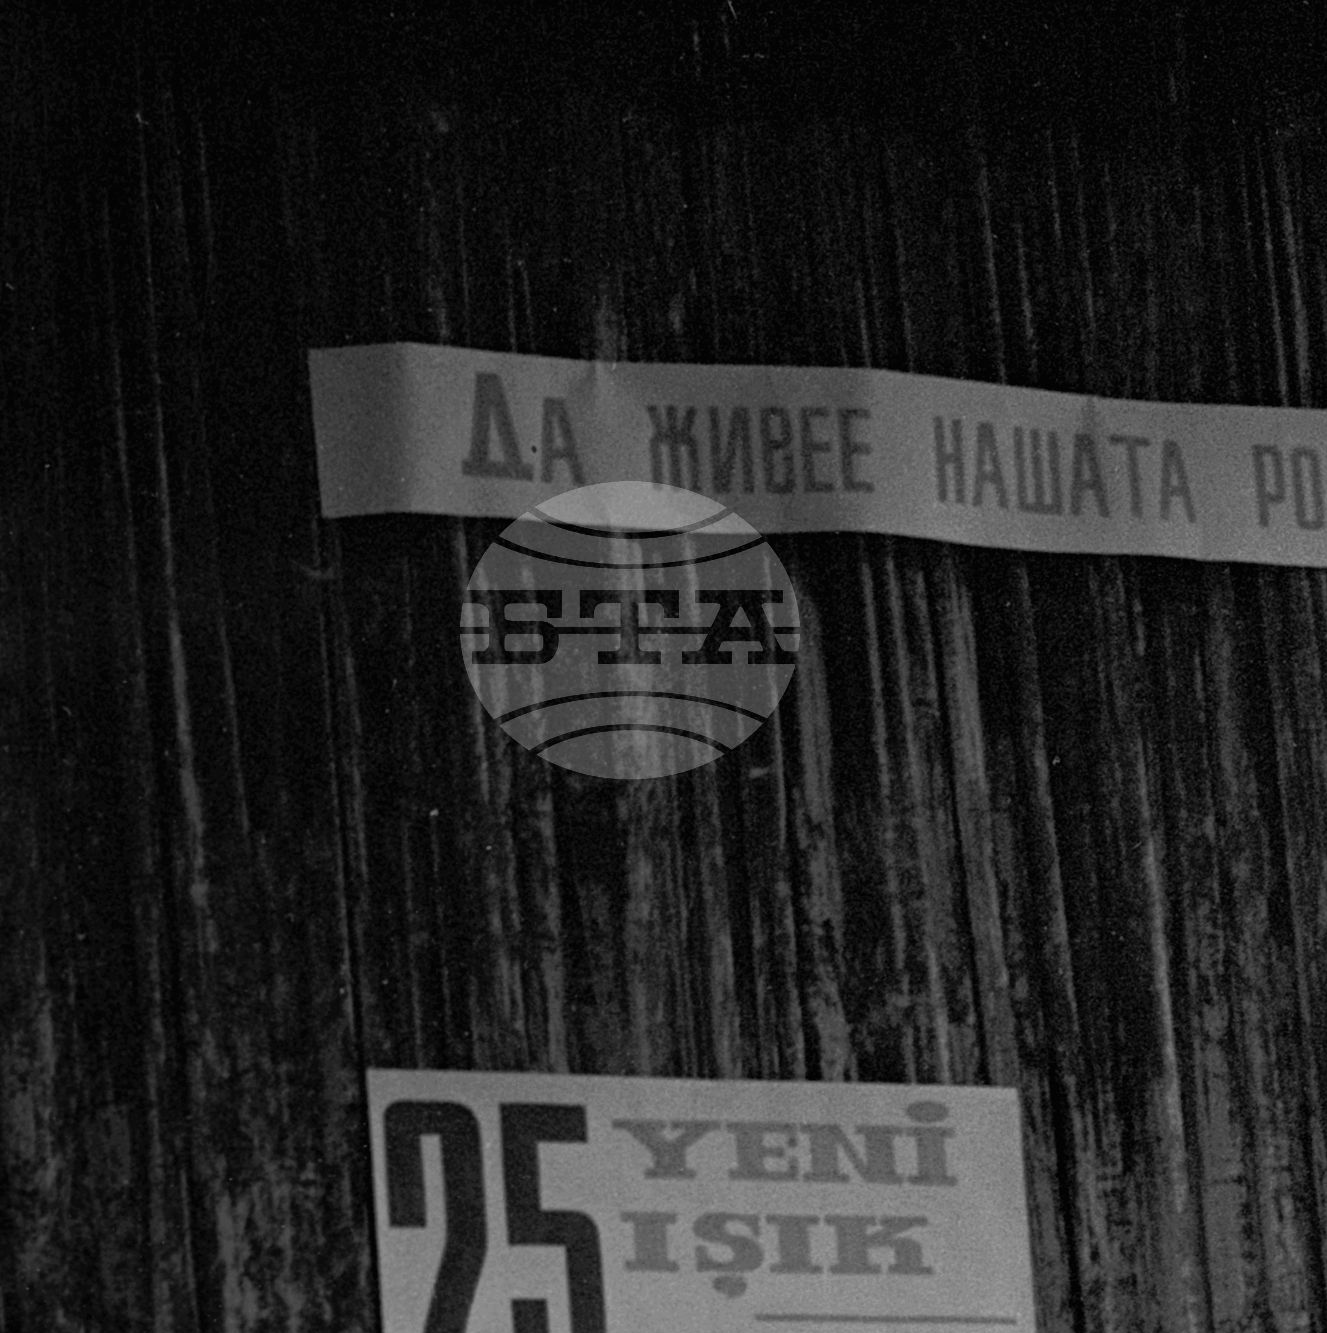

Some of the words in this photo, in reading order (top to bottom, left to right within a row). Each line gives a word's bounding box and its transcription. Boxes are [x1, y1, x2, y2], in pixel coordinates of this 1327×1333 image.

[460, 370, 587, 486] ДА
[646, 402, 876, 495] ЖИВЕЕ
[933, 414, 1199, 524] НАШАТА
[620, 1210, 936, 1299] IŞIK
